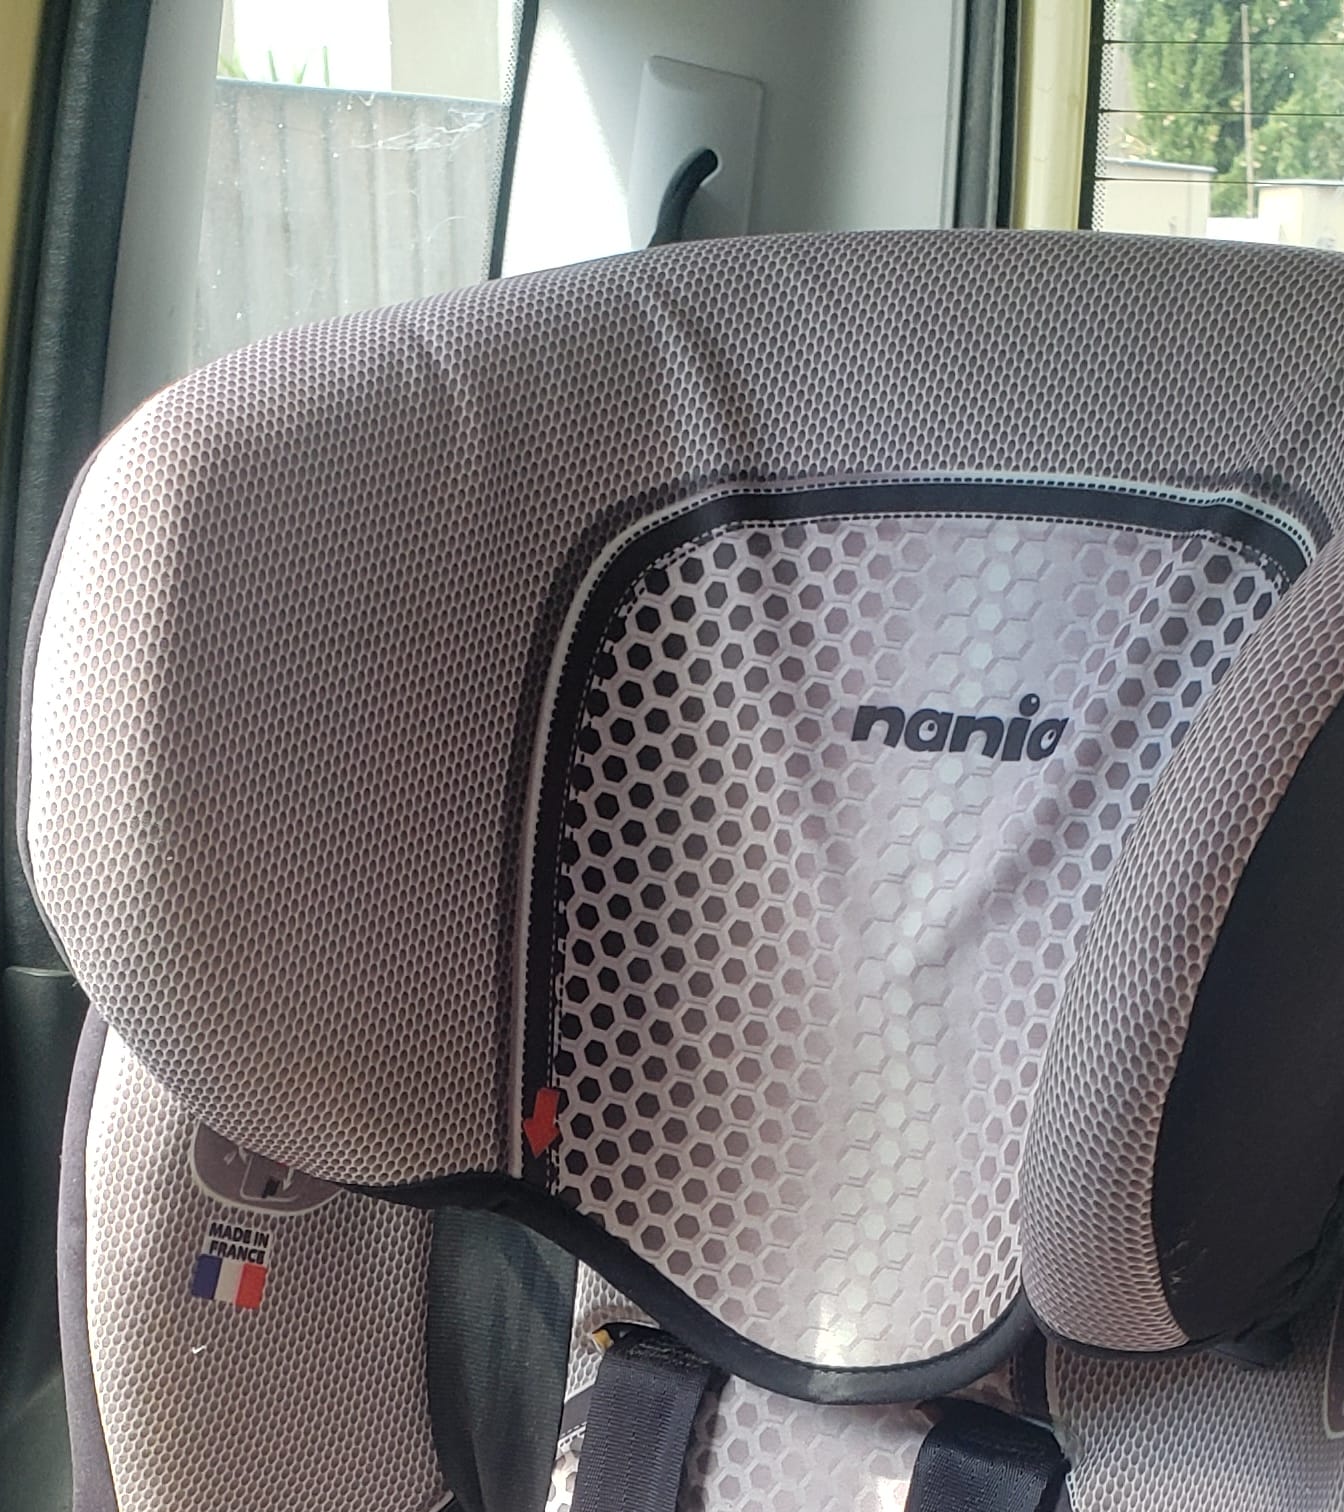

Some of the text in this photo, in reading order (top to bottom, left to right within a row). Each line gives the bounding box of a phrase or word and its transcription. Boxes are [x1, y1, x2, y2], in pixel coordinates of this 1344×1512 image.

[851, 693, 1069, 762] nania
[209, 1222, 270, 1248] MADE IN
[209, 1240, 266, 1264] FRANCE
